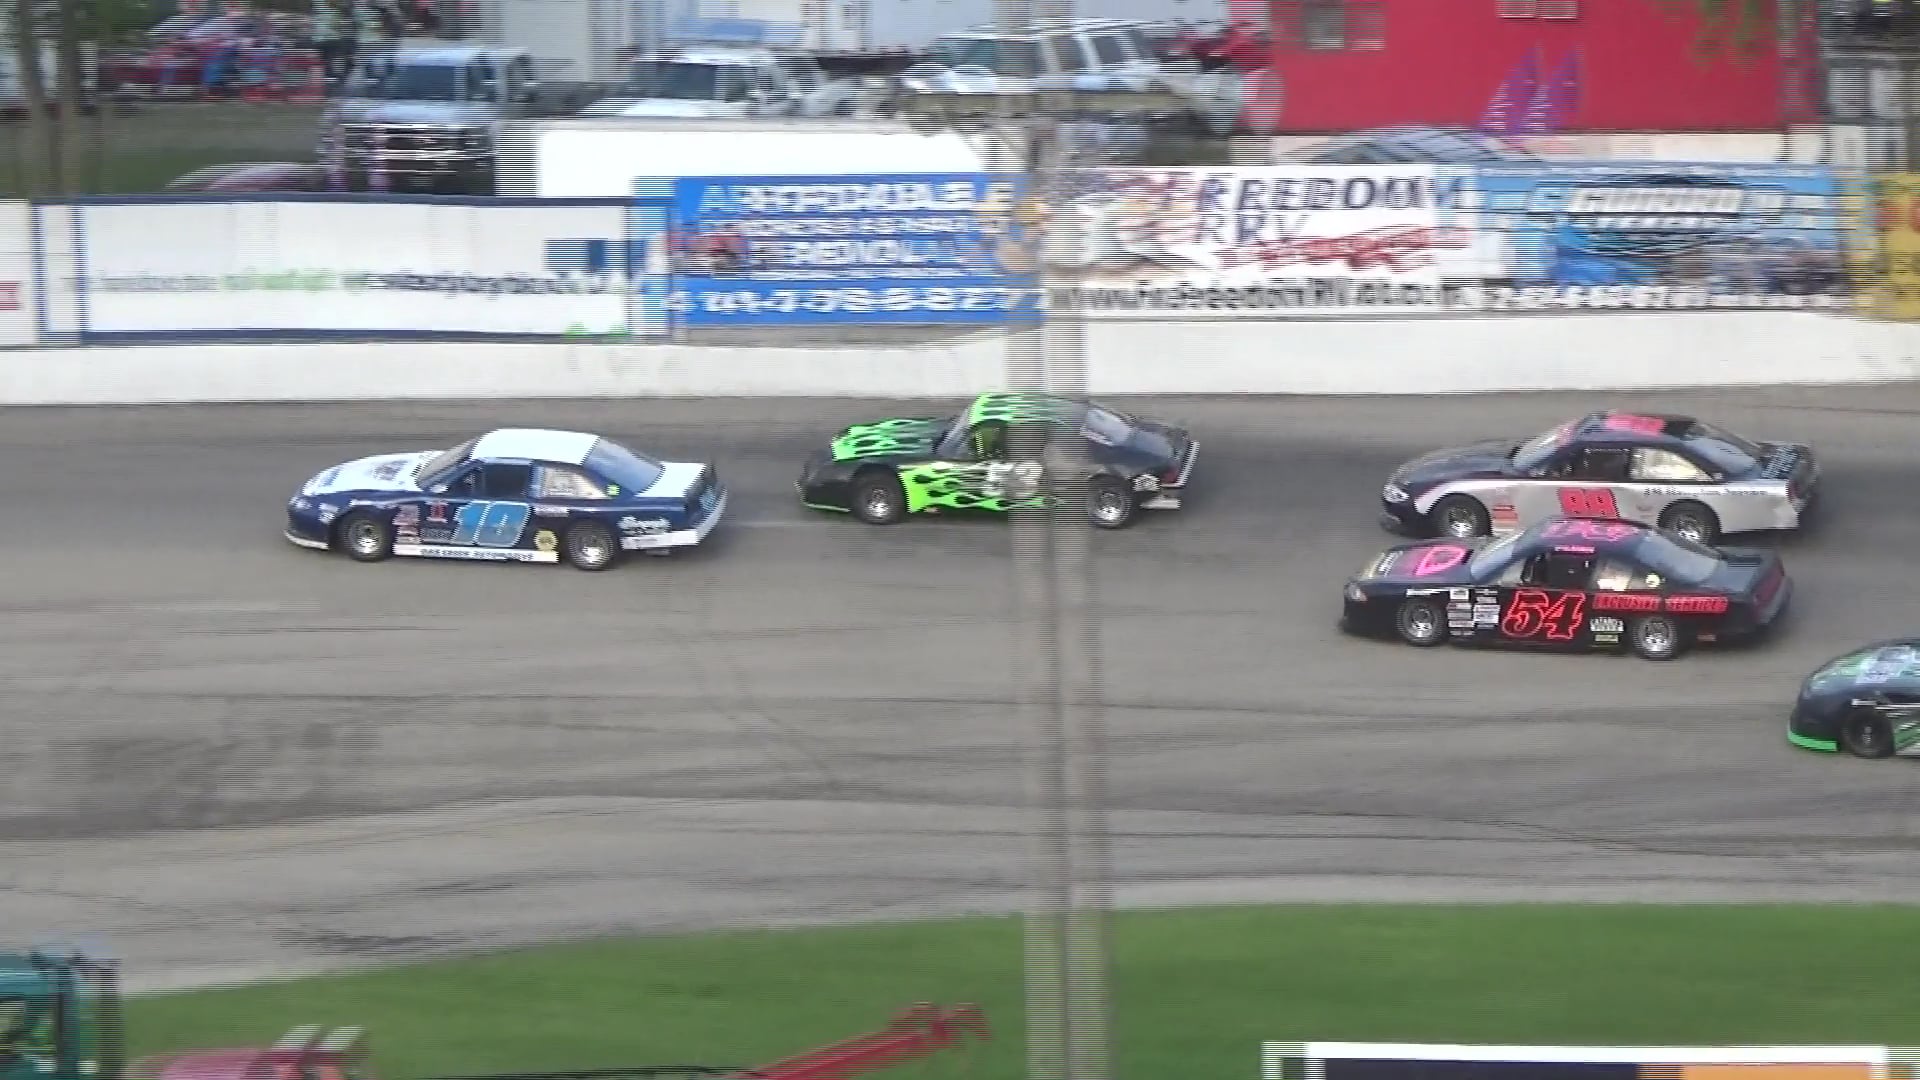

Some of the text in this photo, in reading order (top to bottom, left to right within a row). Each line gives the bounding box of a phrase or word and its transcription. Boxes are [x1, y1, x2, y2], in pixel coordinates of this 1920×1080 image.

[698, 181, 1014, 215] AFFORDABLE
[1159, 171, 1462, 212] FREEDOM
[452, 500, 532, 548] 10
[1501, 590, 1587, 640] 54
